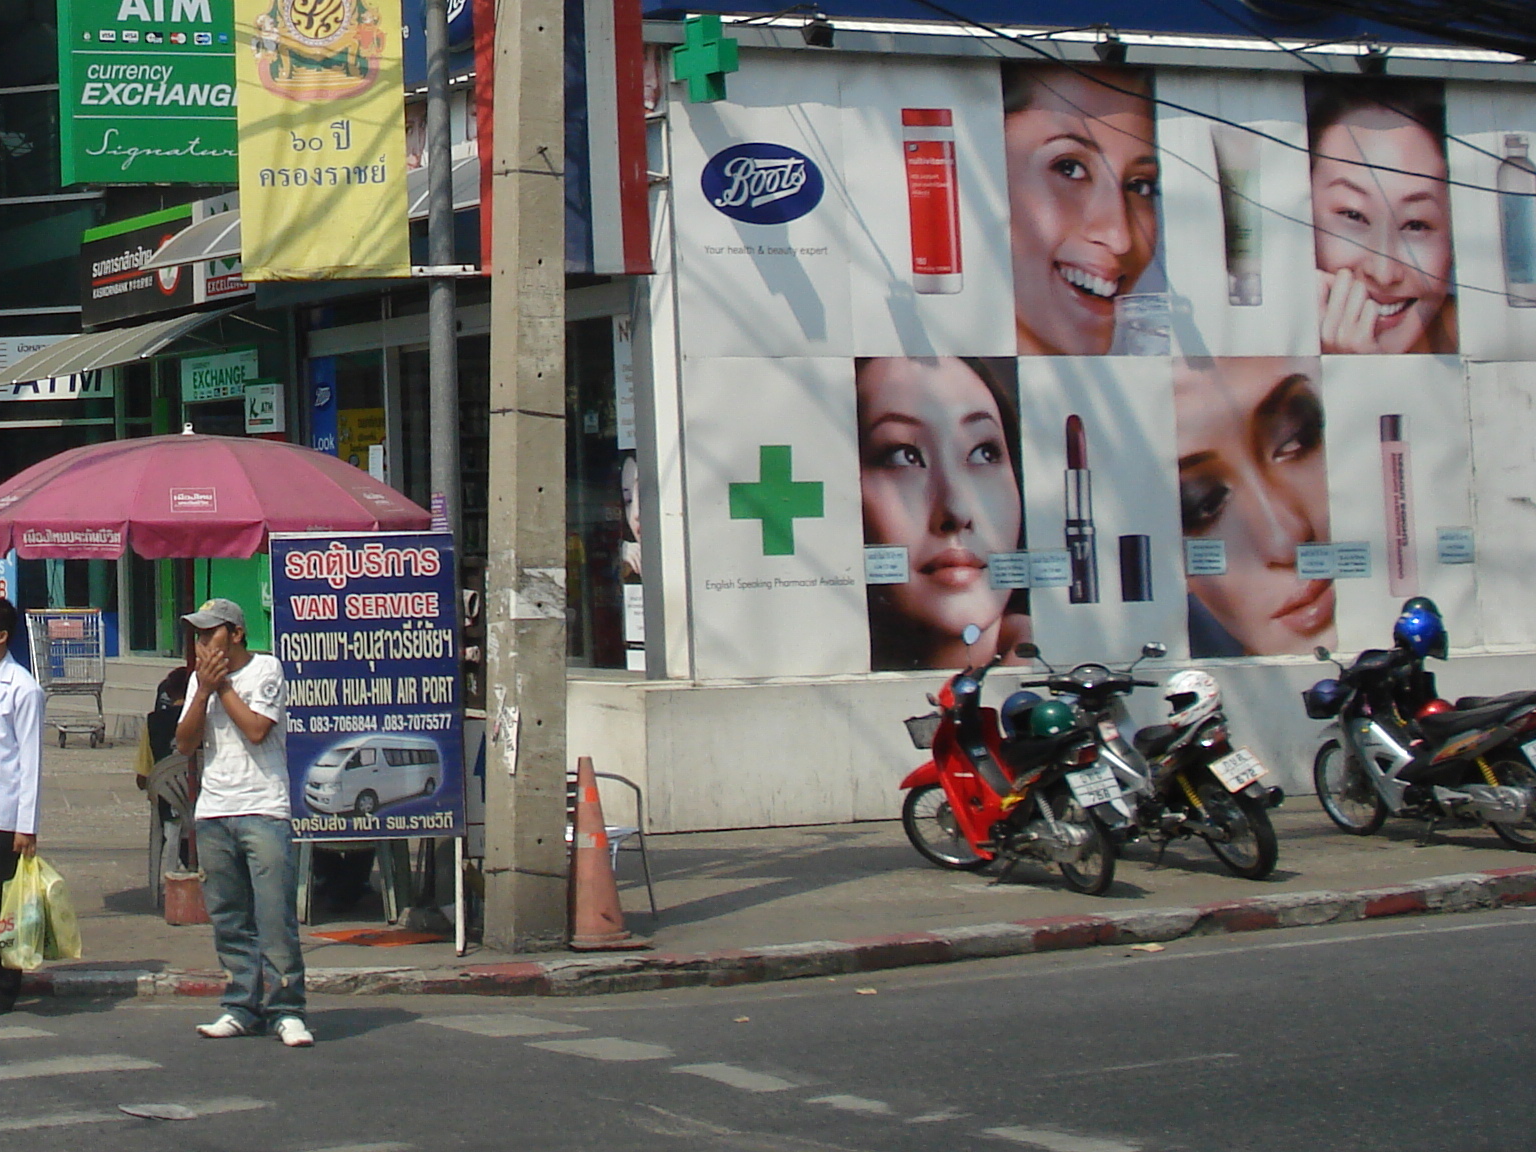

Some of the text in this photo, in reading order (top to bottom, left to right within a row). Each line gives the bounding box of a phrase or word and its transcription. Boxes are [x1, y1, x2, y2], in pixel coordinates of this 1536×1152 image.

[87, 64, 173, 83] currency
[85, 128, 238, 171] Signatur
[291, 120, 351, 151] ๖๐ ปี
[259, 154, 386, 187] ครองราชย์
[714, 156, 806, 208] Boots
[92, 246, 153, 278] ธนาคารกสิกรไทย
[704, 245, 725, 255] Your
[728, 245, 755, 255] health
[768, 245, 796, 257] beauty
[800, 246, 828, 256] expert
[192, 365, 246, 389] EXCHANGE
[286, 541, 440, 588] รถตู้บริการ
[705, 575, 855, 591] English Speaking Pharmacist Available
[290, 592, 440, 620] VAN SERVICE
[342, 678, 392, 706] HUA-HIN
[397, 677, 418, 705] AIR
[422, 676, 454, 704] PORT
[310, 715, 378, 732] 083-7068844
[291, 810, 453, 837] จุดรับส่ง หน้า รพ.ราชวิถี
